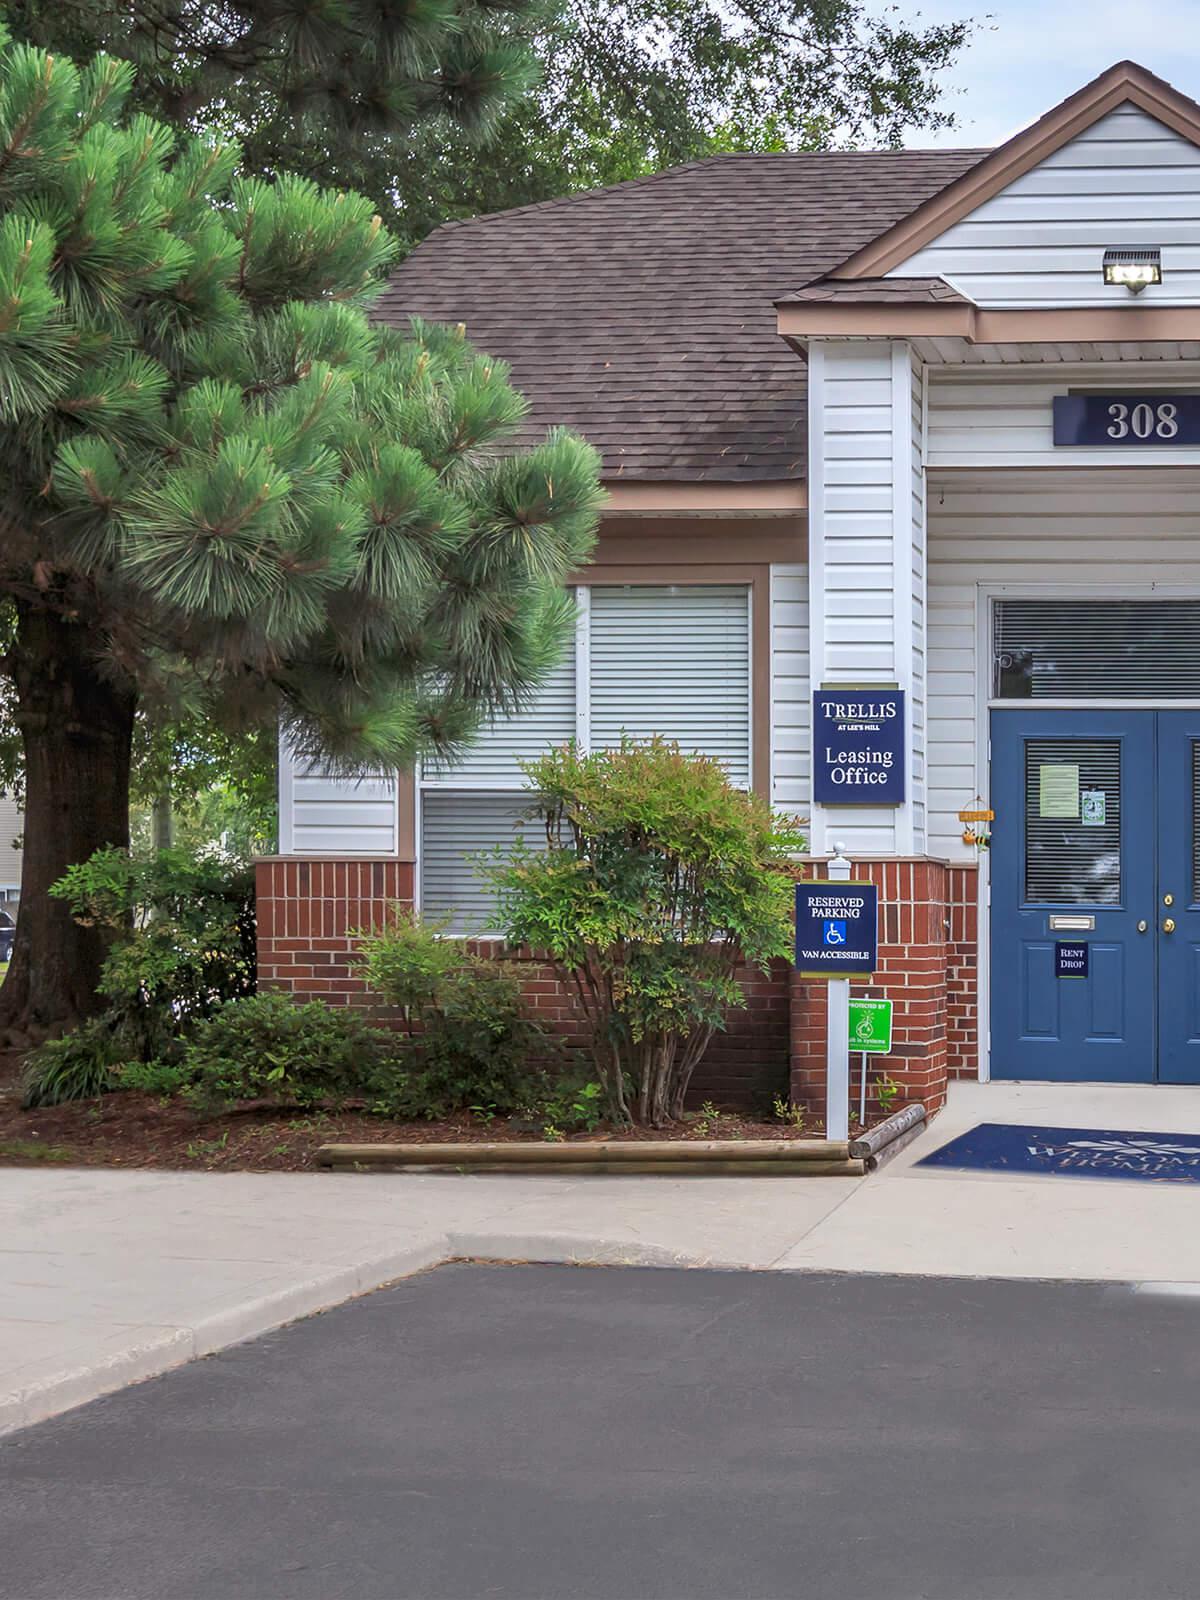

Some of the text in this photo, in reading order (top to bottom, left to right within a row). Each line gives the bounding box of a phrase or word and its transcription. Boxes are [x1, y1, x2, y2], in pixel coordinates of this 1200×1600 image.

[1106, 403, 1179, 439] 308
[821, 702, 897, 718] TRELLIS
[825, 747, 894, 768] Leasing
[830, 767, 888, 785] Office
[807, 896, 865, 908] RESERVED
[811, 907, 861, 919] PARKING
[801, 950, 870, 960] VAN ACCESSIBLE
[1060, 948, 1085, 958] RENT
[1060, 959, 1085, 969] DROP
